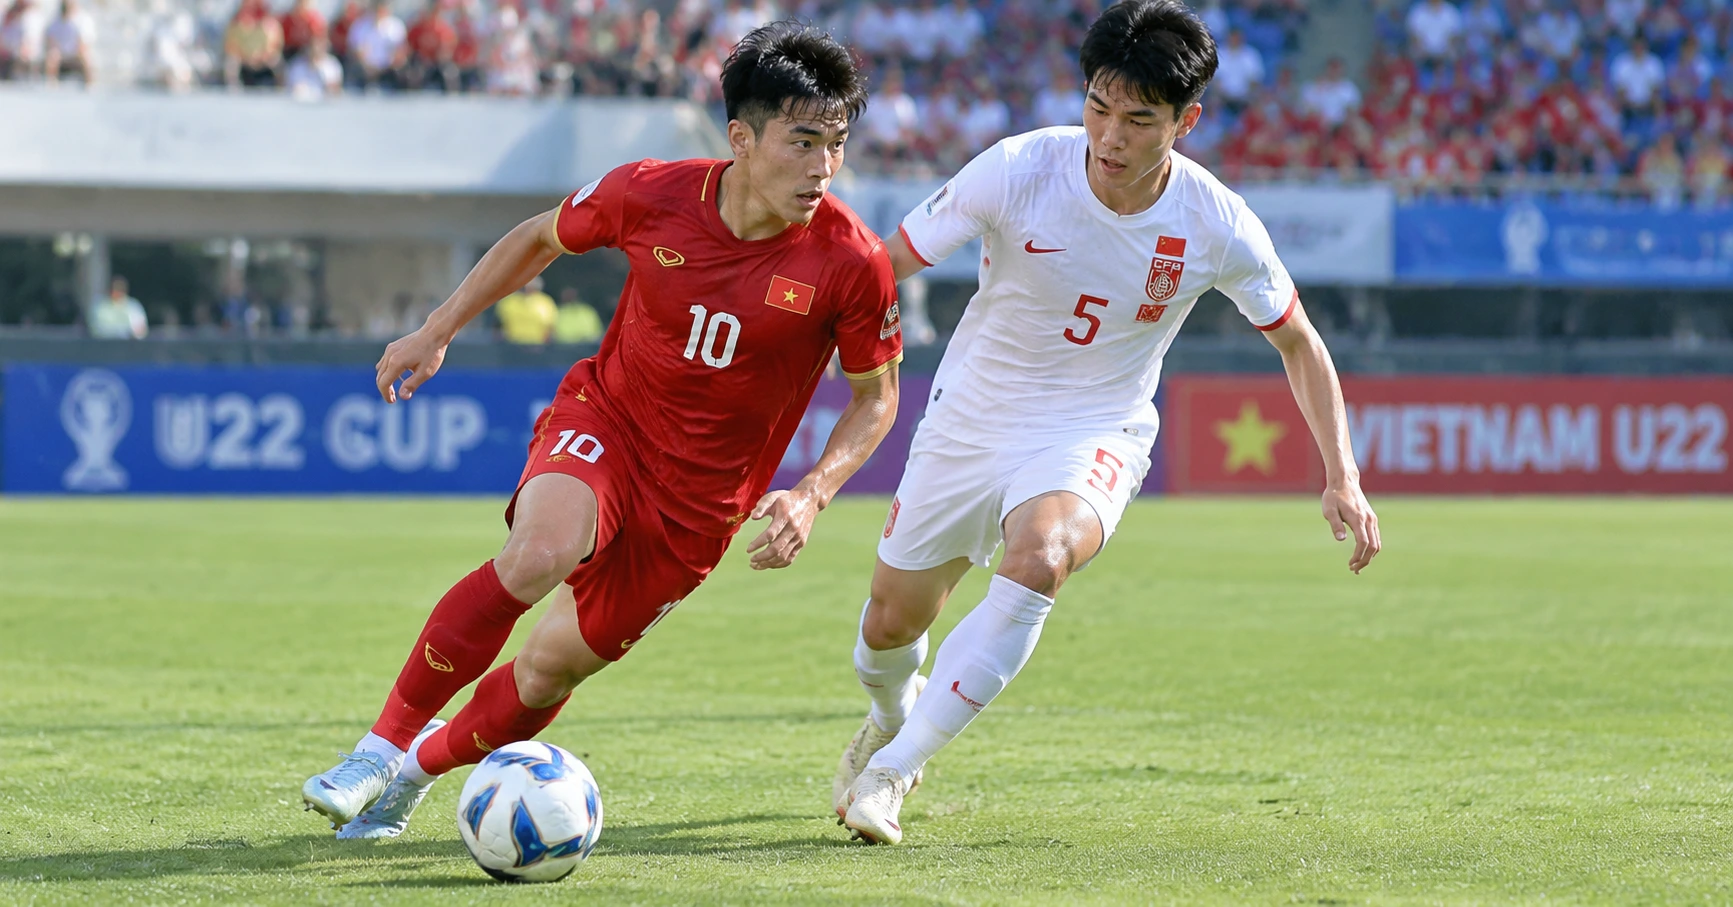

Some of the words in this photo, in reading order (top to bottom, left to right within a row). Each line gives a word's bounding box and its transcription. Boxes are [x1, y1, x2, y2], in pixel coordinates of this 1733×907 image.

[683, 304, 741, 368] 10
[1063, 293, 1109, 345] 5
[155, 397, 304, 468] U22
[326, 397, 484, 468] CUP
[549, 430, 605, 463] 10
[1347, 405, 1597, 473] VIETNAM
[1613, 405, 1727, 473] U22
